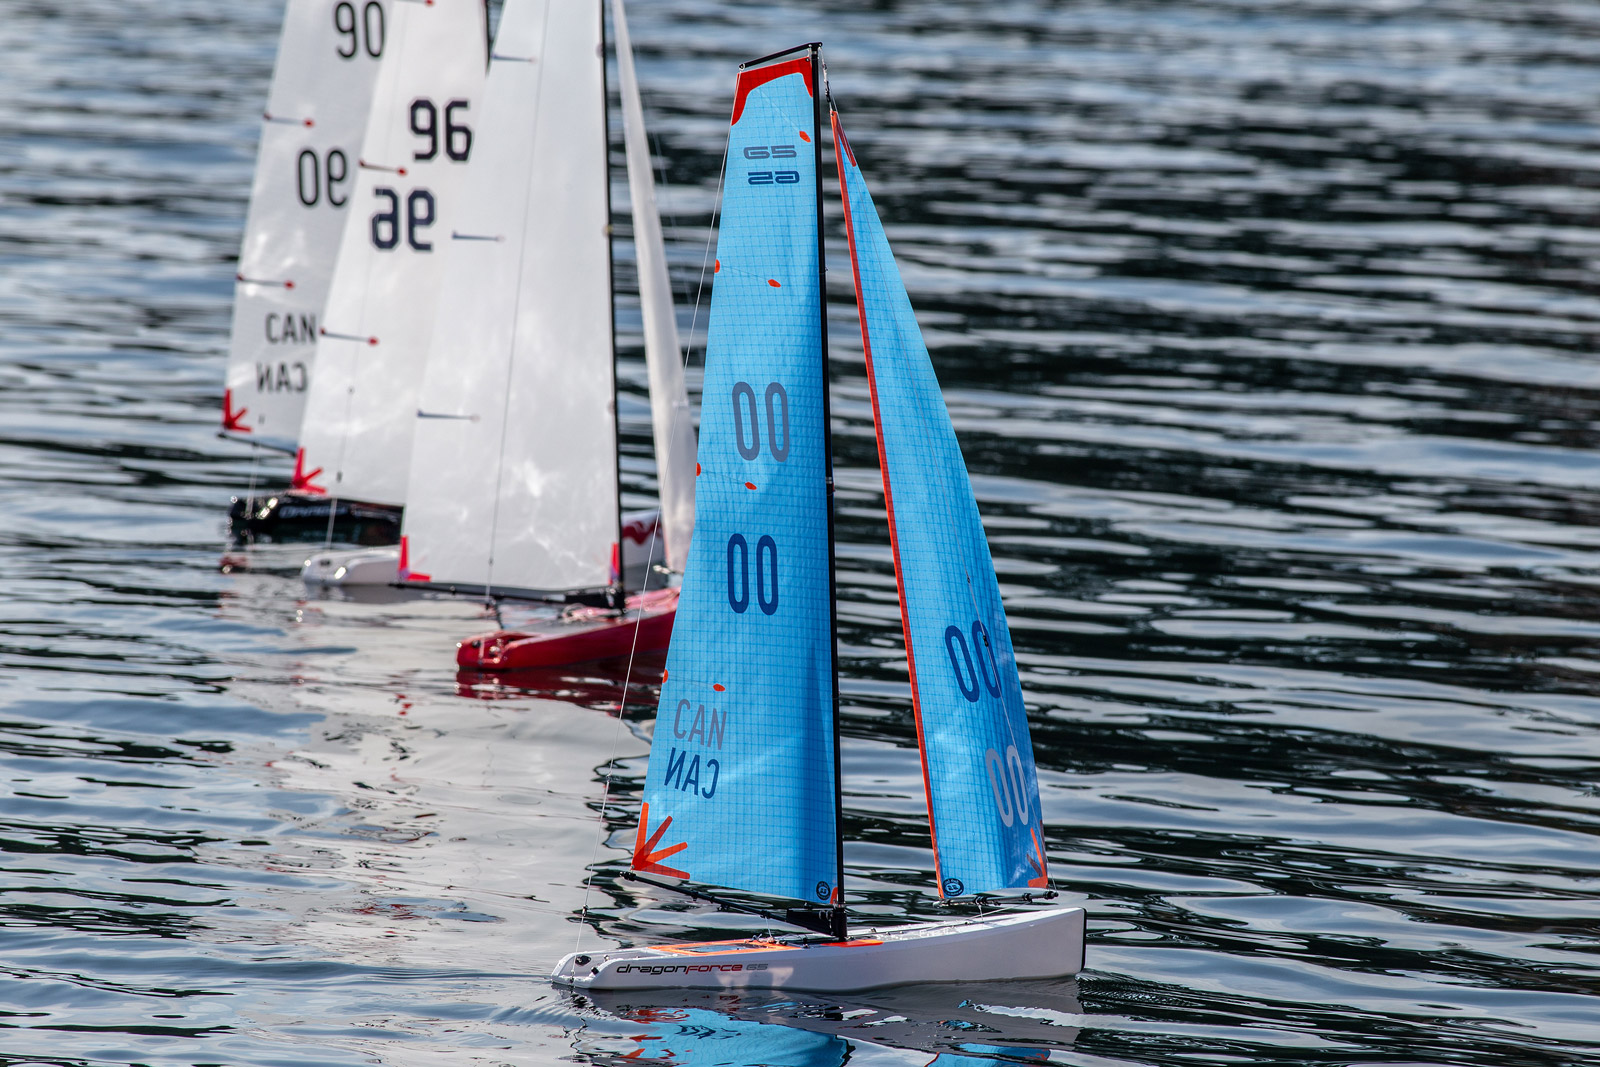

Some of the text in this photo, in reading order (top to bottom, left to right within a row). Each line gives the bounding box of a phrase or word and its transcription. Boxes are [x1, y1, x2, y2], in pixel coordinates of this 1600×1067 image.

[335, 1, 384, 58] 90
[410, 99, 472, 161] 96
[743, 145, 797, 159] 65
[265, 312, 317, 345] CAN
[732, 381, 790, 462] 00
[727, 533, 779, 616] 00
[944, 620, 1001, 702] 00
[673, 699, 727, 750] CAN
[985, 745, 1028, 828] 00
[616, 963, 768, 975] dragonforce 65
